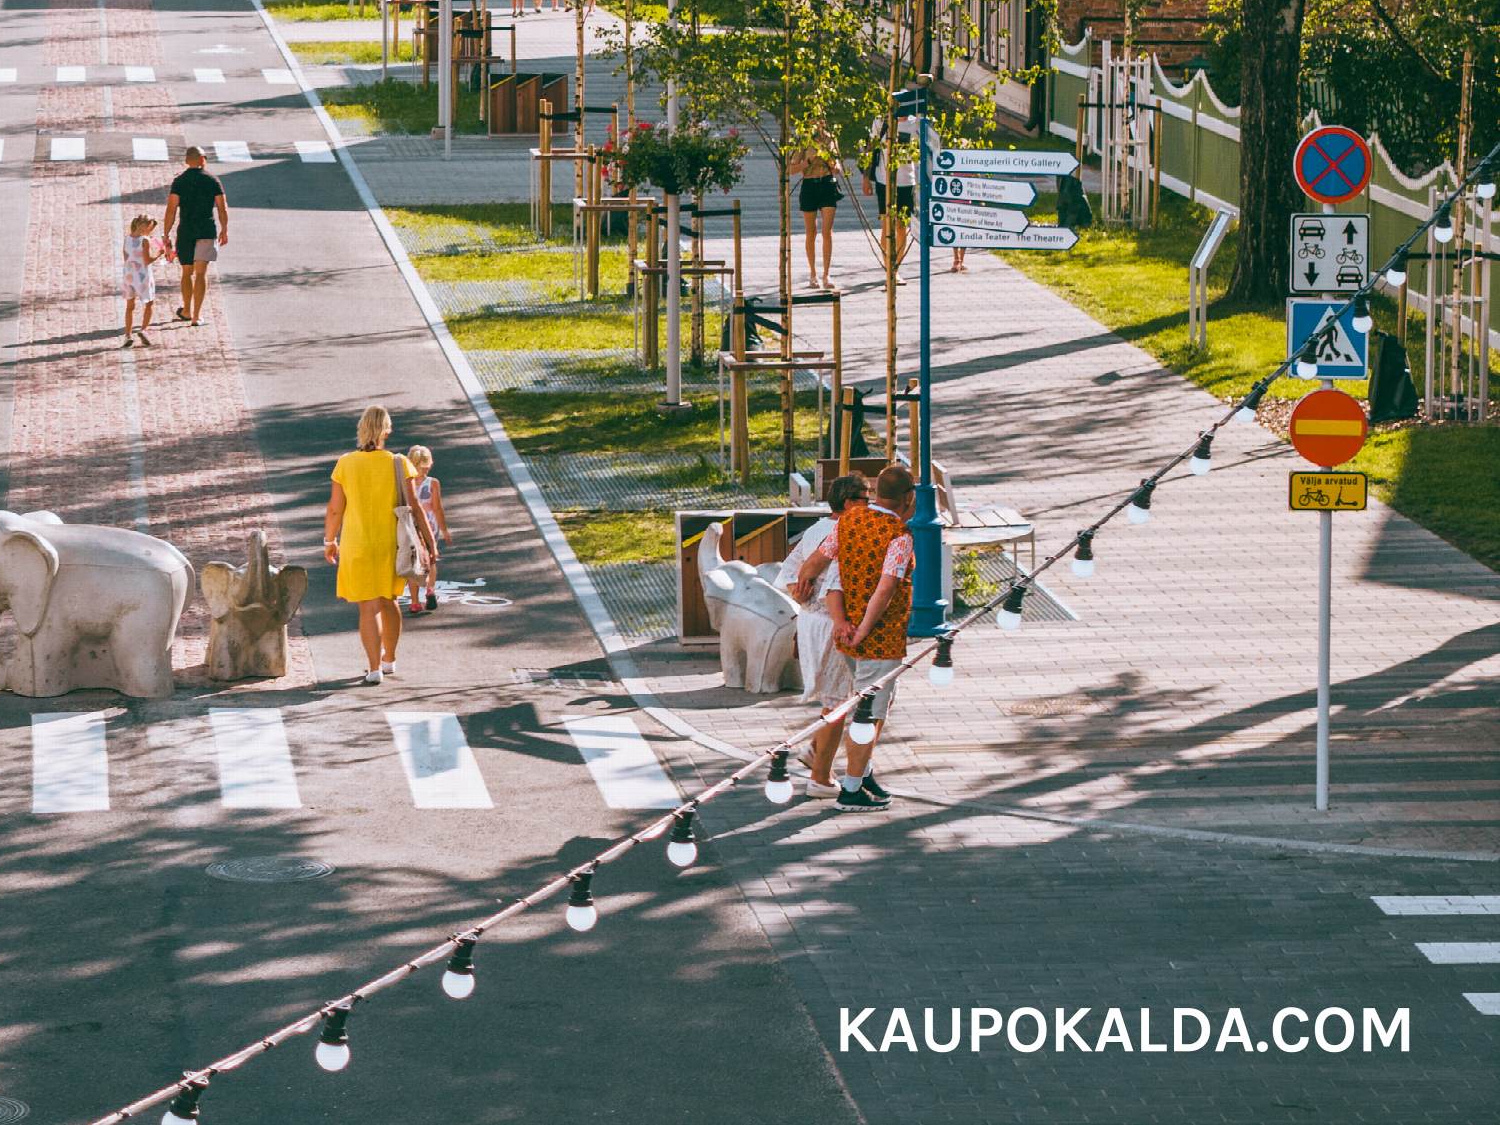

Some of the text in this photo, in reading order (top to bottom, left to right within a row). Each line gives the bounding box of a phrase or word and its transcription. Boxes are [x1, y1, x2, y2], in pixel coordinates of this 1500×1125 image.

[1013, 158, 1029, 169] City
[1031, 158, 1061, 169] Gallery
[960, 232, 1064, 243] Endla Teater The Theatre
[1300, 477, 1358, 486] Välja arvatud
